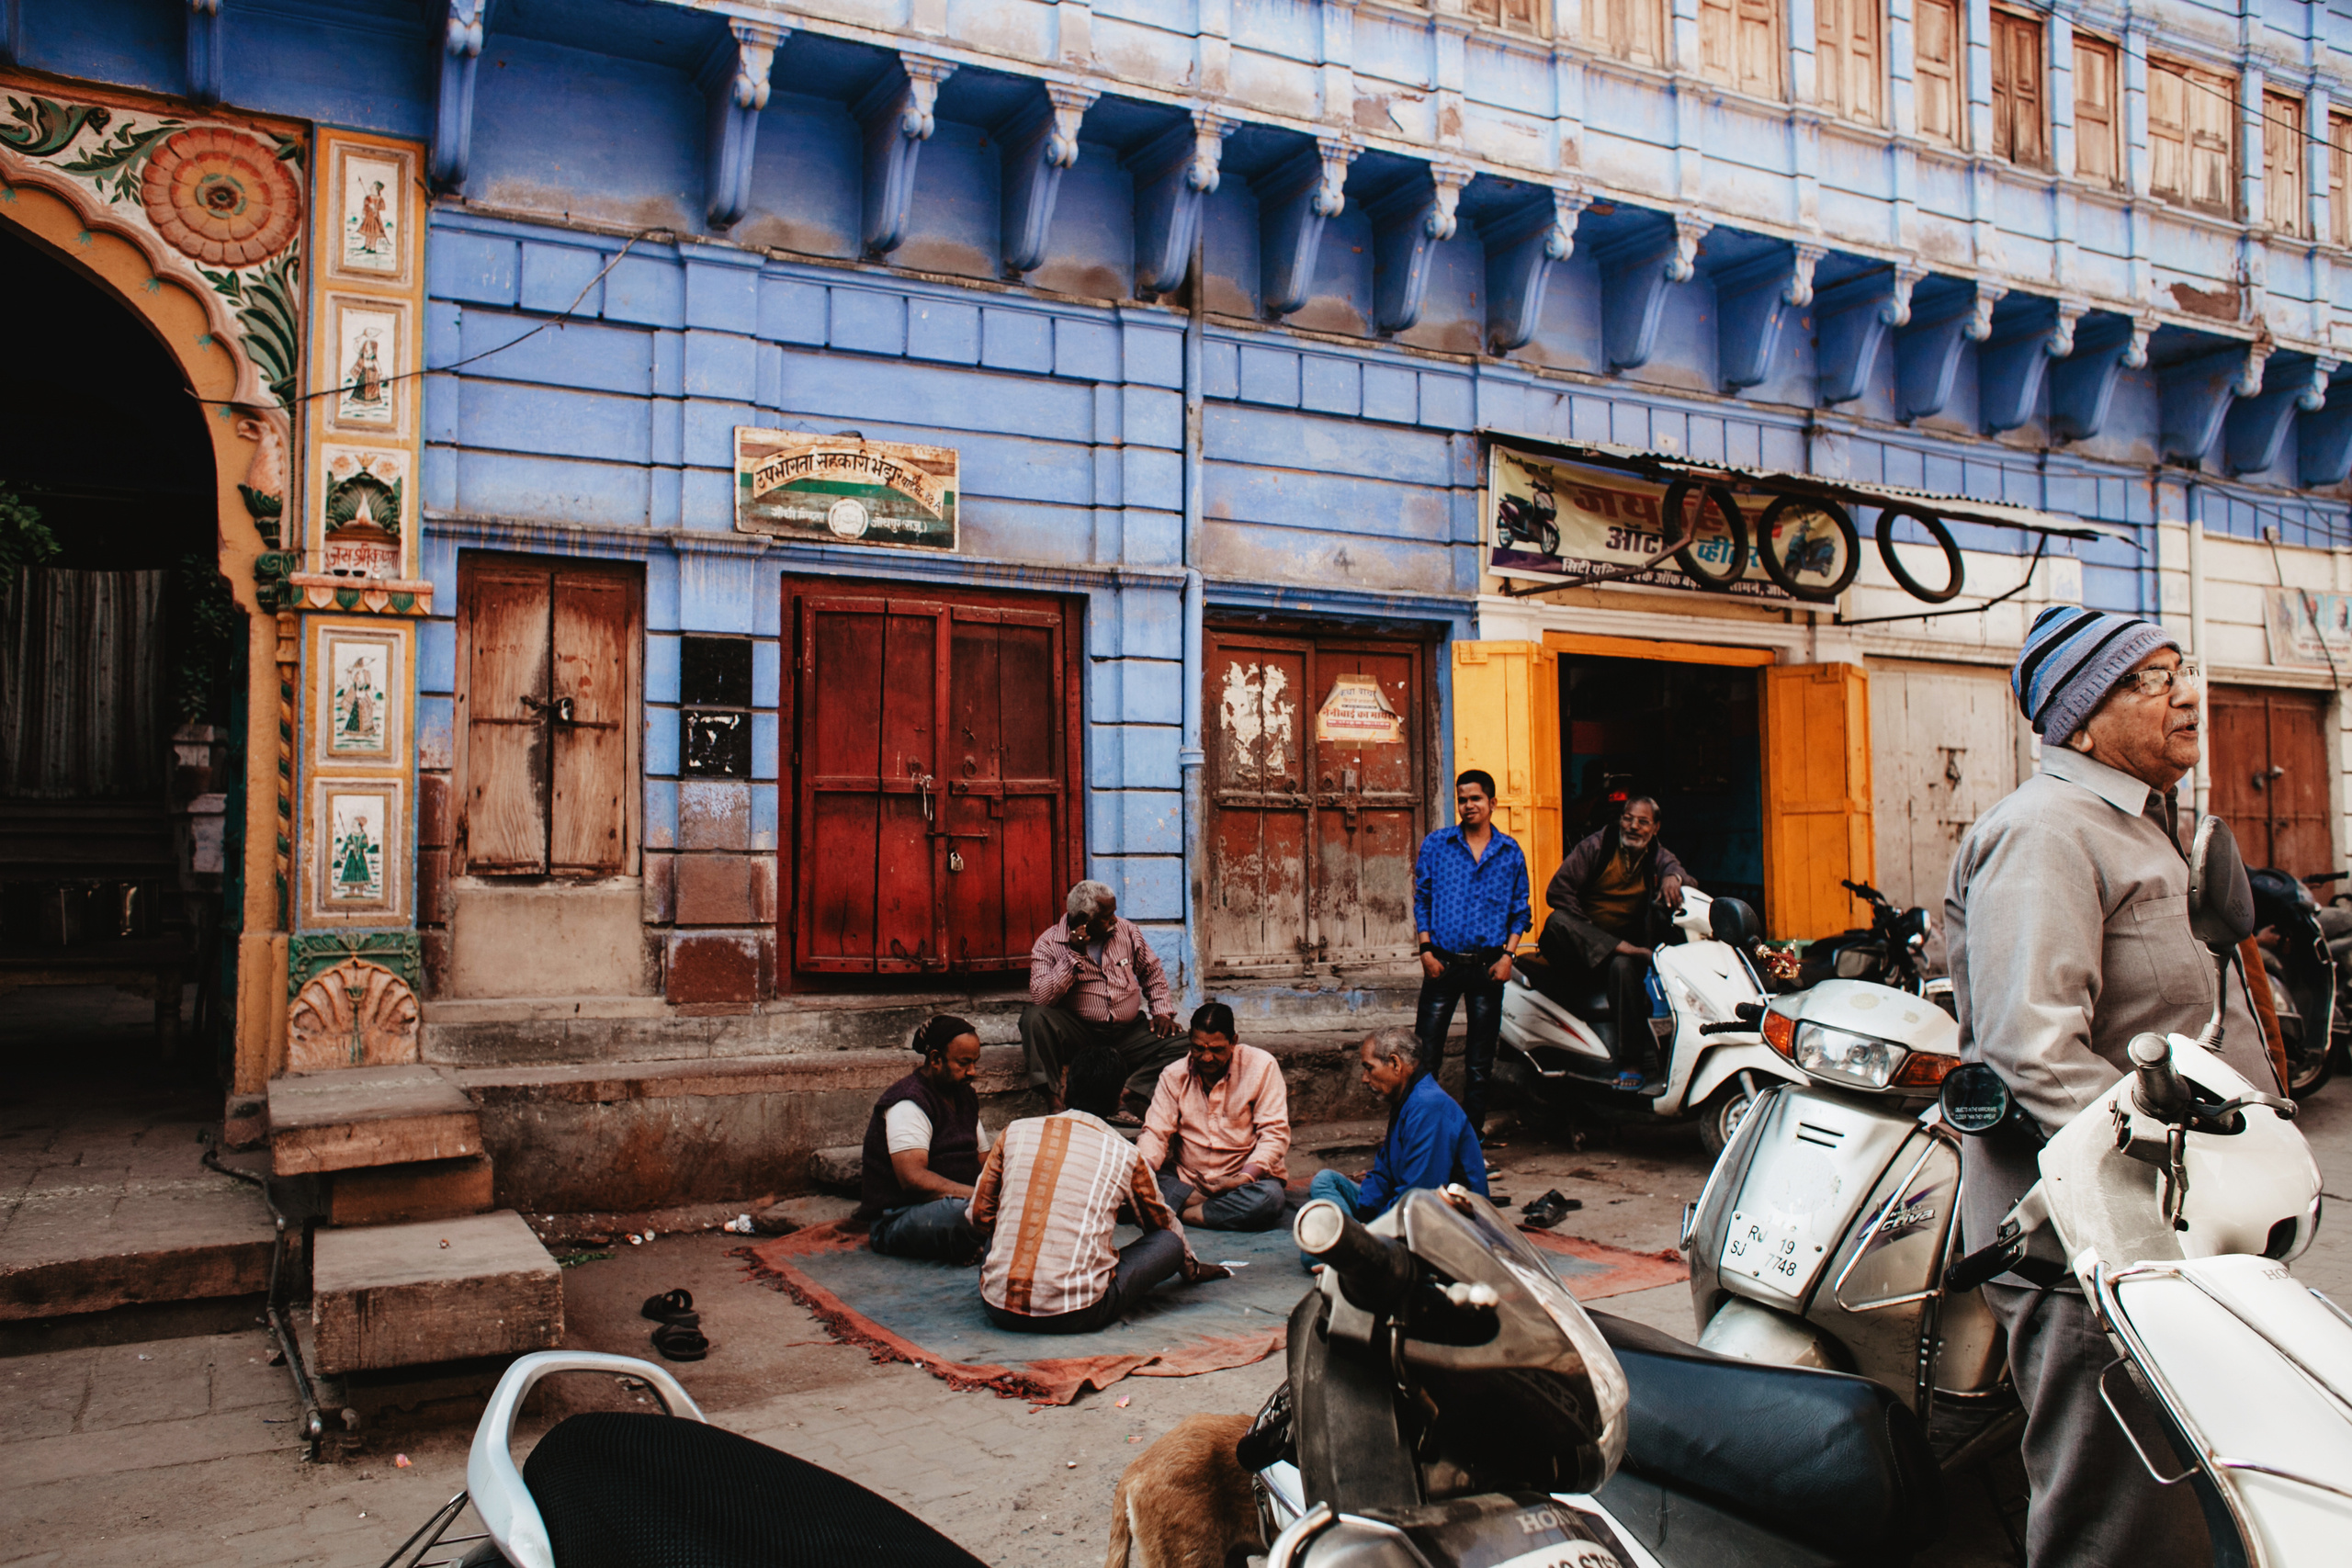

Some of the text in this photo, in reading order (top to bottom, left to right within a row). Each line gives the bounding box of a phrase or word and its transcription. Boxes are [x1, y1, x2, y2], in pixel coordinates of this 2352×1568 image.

[1697, 536, 1759, 568] व्हीर
[1780, 1238, 1795, 1255] 19
[1764, 1252, 1797, 1277] 7748
